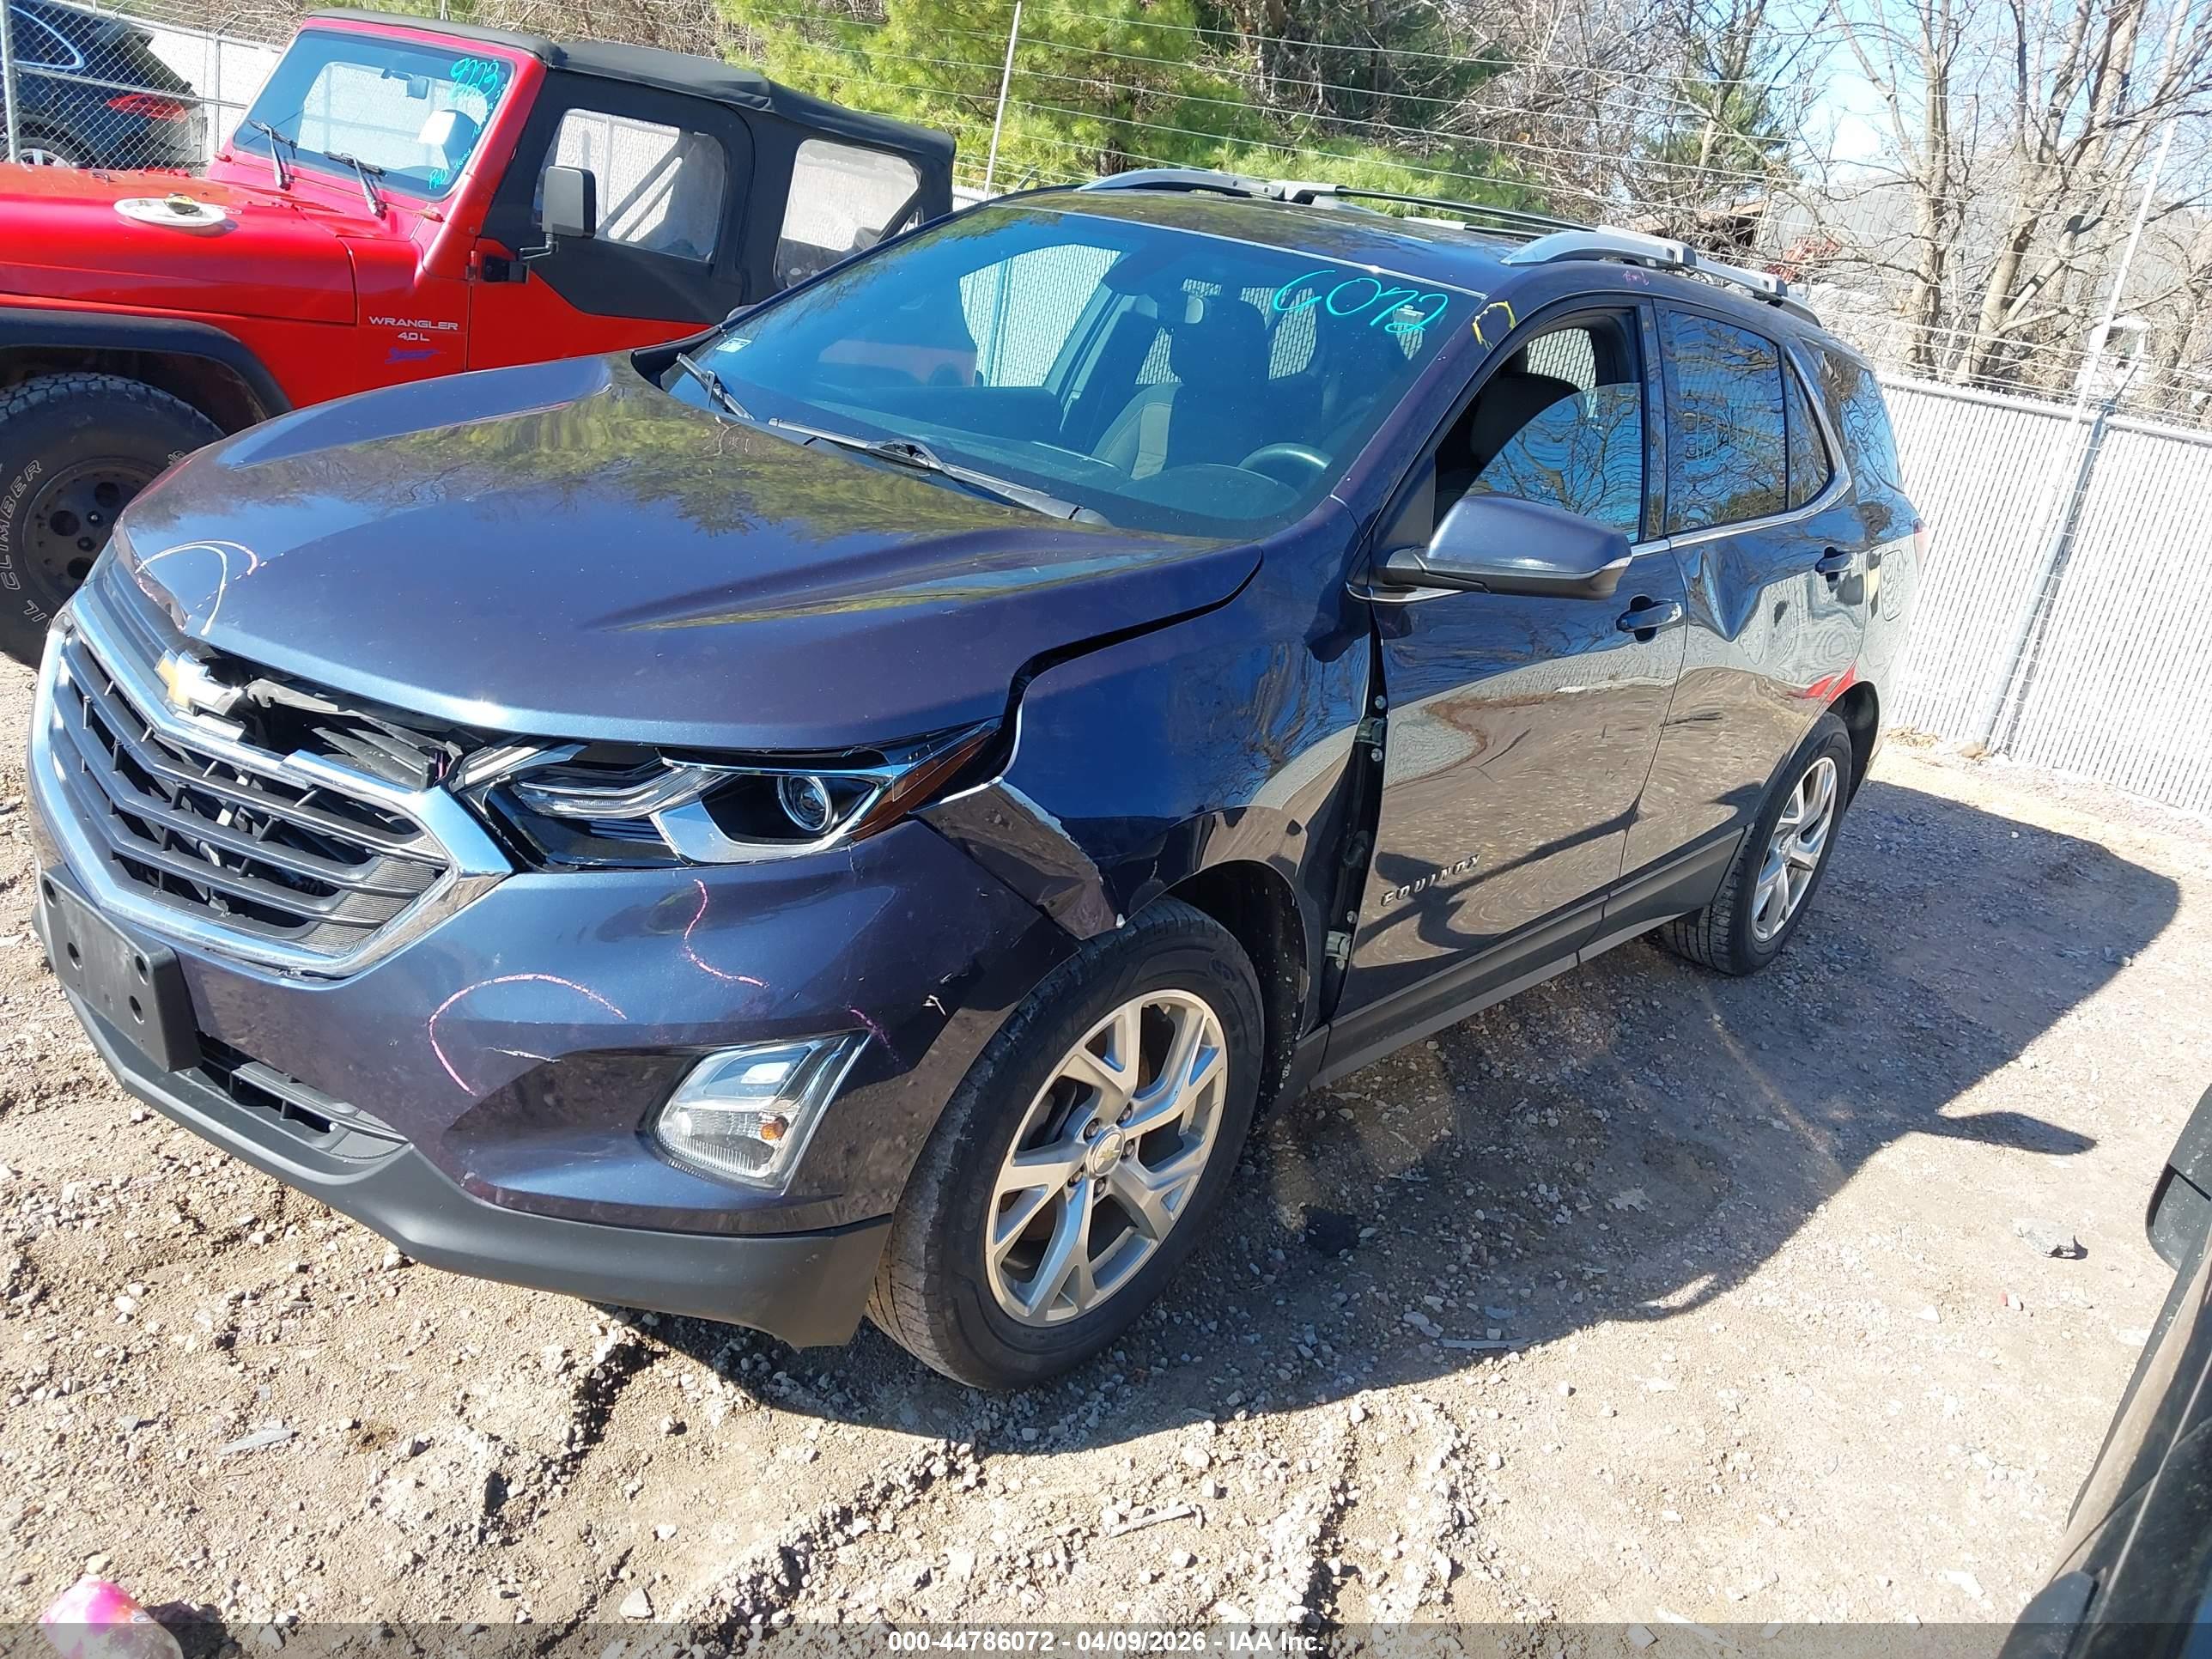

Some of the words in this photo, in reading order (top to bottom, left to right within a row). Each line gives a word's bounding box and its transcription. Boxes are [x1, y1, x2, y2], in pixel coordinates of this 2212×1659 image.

[368, 315, 459, 331] WRANGLER
[1273, 270, 1449, 333] 6072
[1380, 854, 1481, 907] EQUINOX
